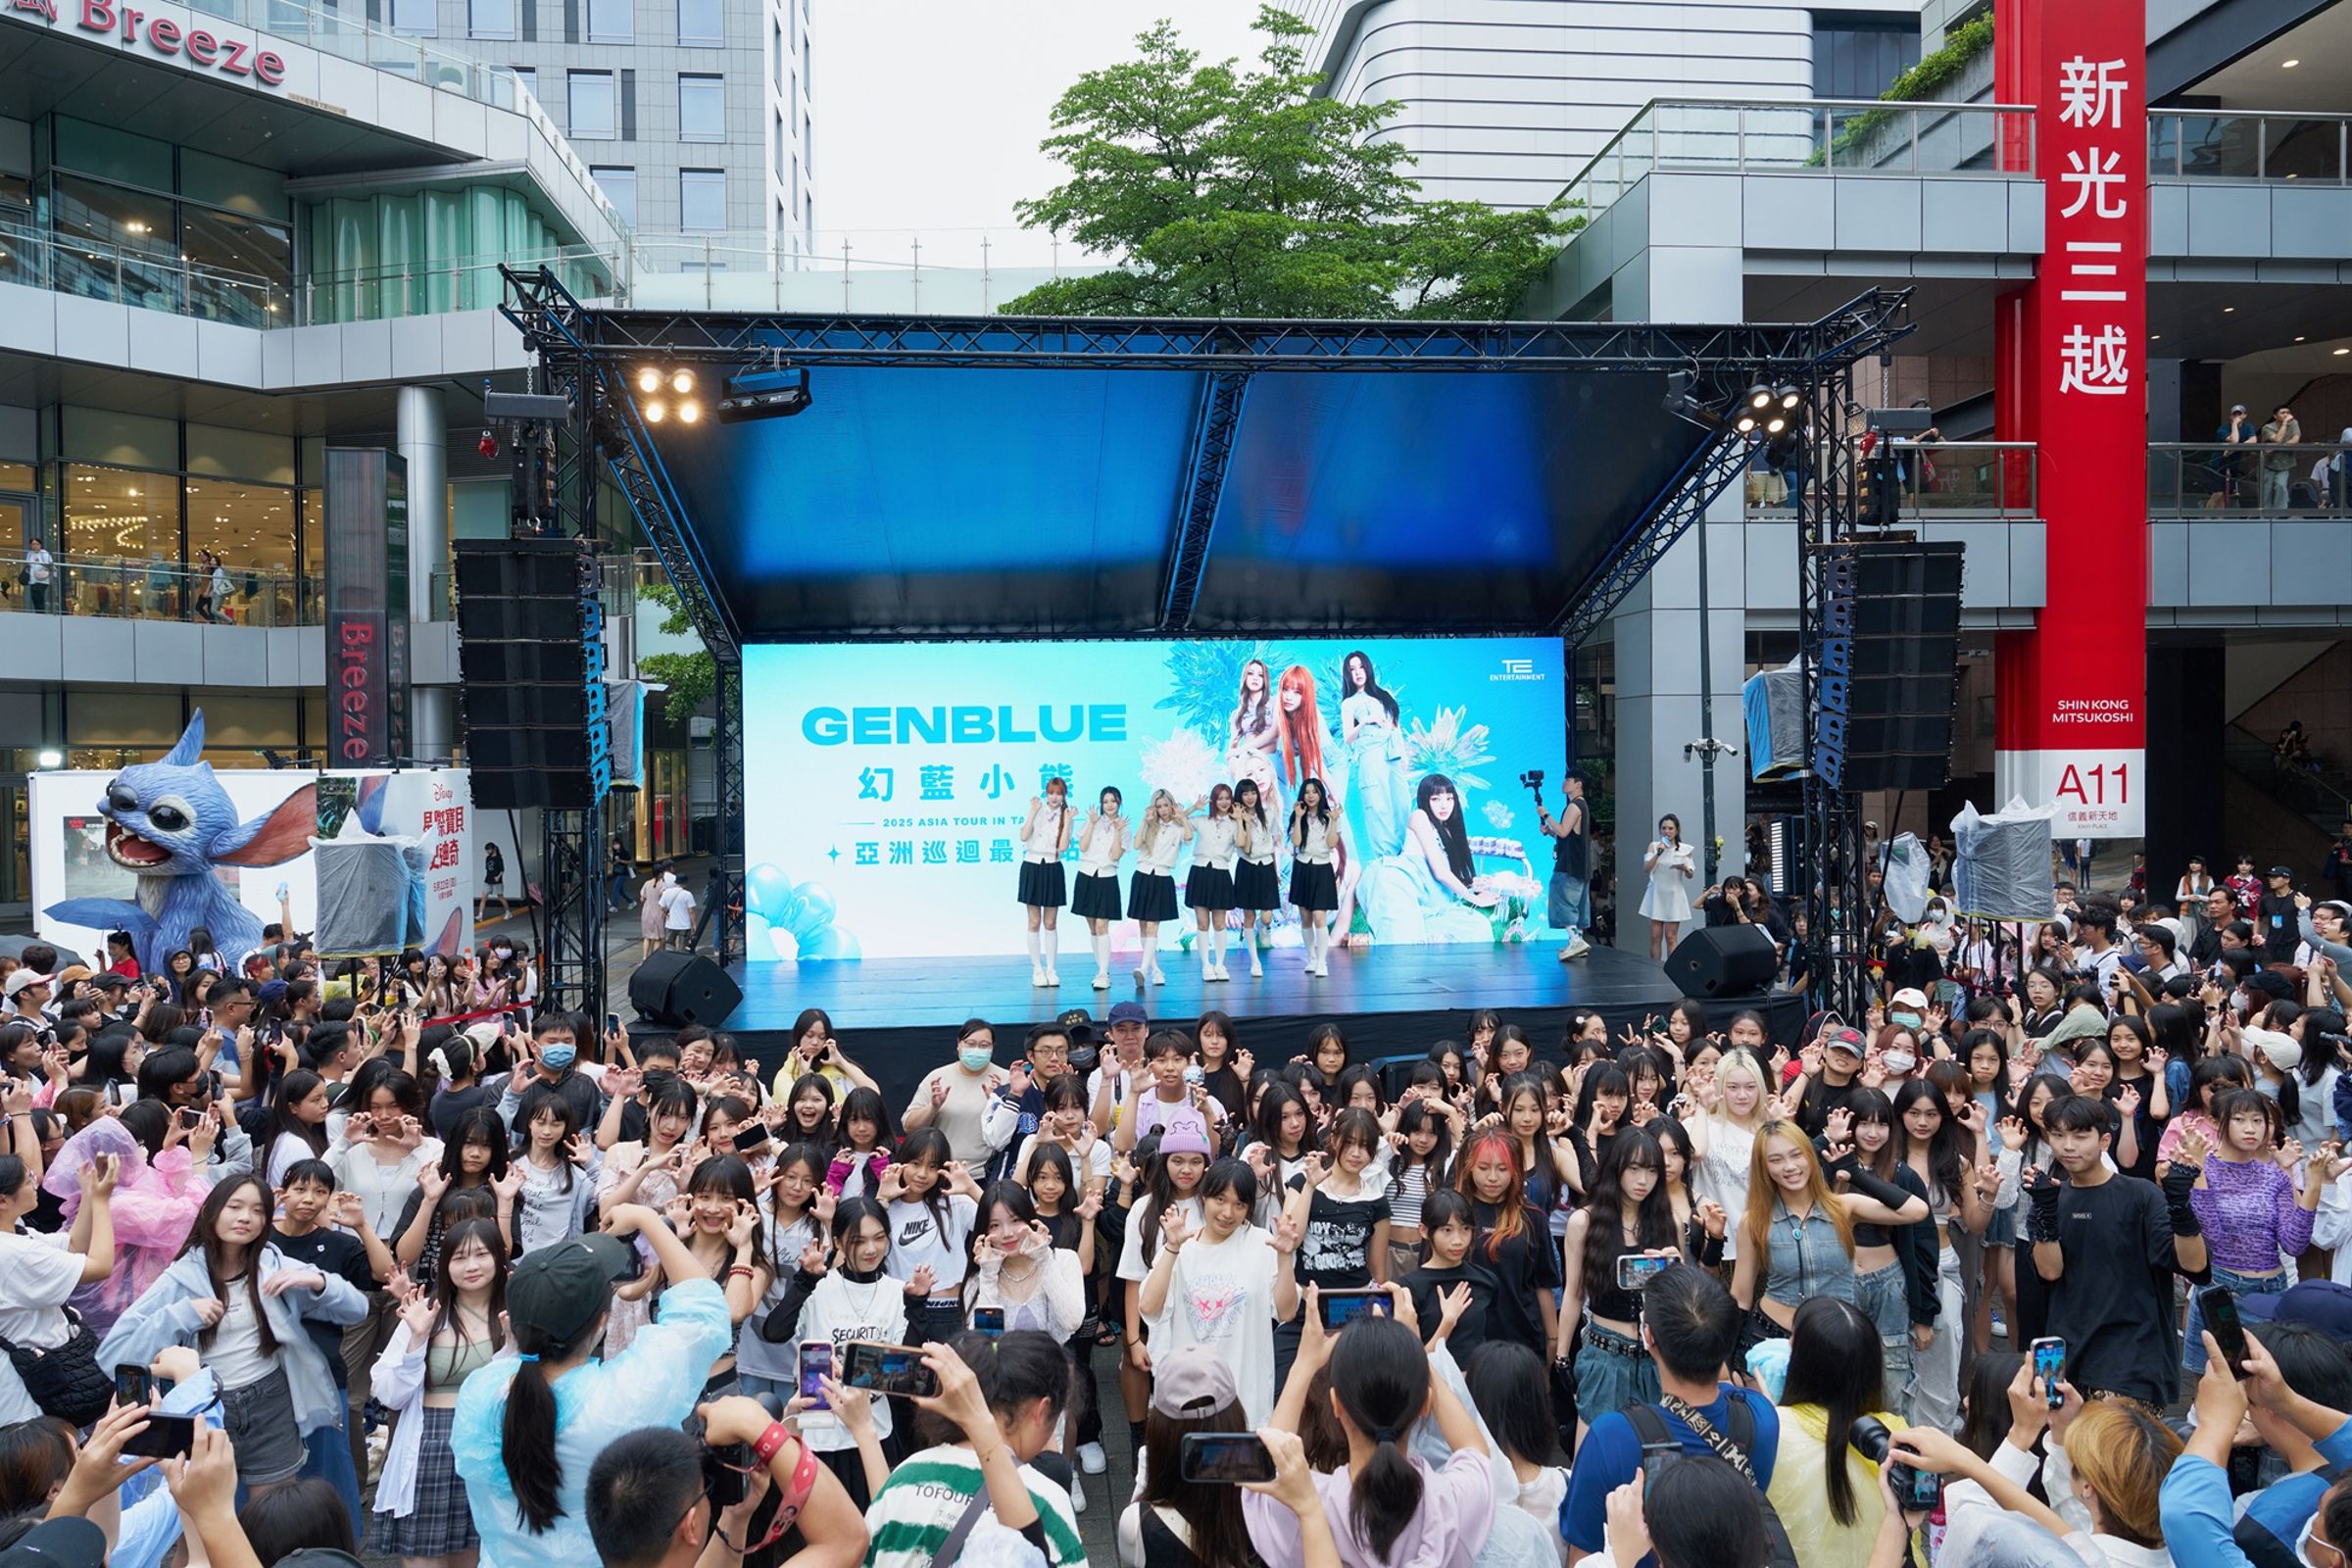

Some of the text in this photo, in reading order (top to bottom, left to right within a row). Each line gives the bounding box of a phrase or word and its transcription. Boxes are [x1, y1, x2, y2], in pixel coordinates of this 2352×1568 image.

[78, 0, 286, 85] Breeze
[2059, 55, 2129, 395] 新光三越
[341, 621, 374, 760] Breeze
[2052, 712, 2133, 723] MITSUKOSHI
[2057, 700, 2130, 710] SHIN KONG
[801, 704, 1128, 746] GENBLUE
[858, 762, 1075, 803] 幻藍小熊
[2056, 762, 2128, 806] A11
[883, 817, 914, 828] 2025
[918, 816, 950, 827] ASIA
[954, 816, 988, 826] TOUR
[992, 815, 1006, 826] IN
[2067, 810, 2119, 822] 信義新天地
[855, 838, 1080, 865] 亞洲巡迴最站
[905, 1218, 930, 1236] NIKE
[832, 1326, 883, 1345] SECURITY
